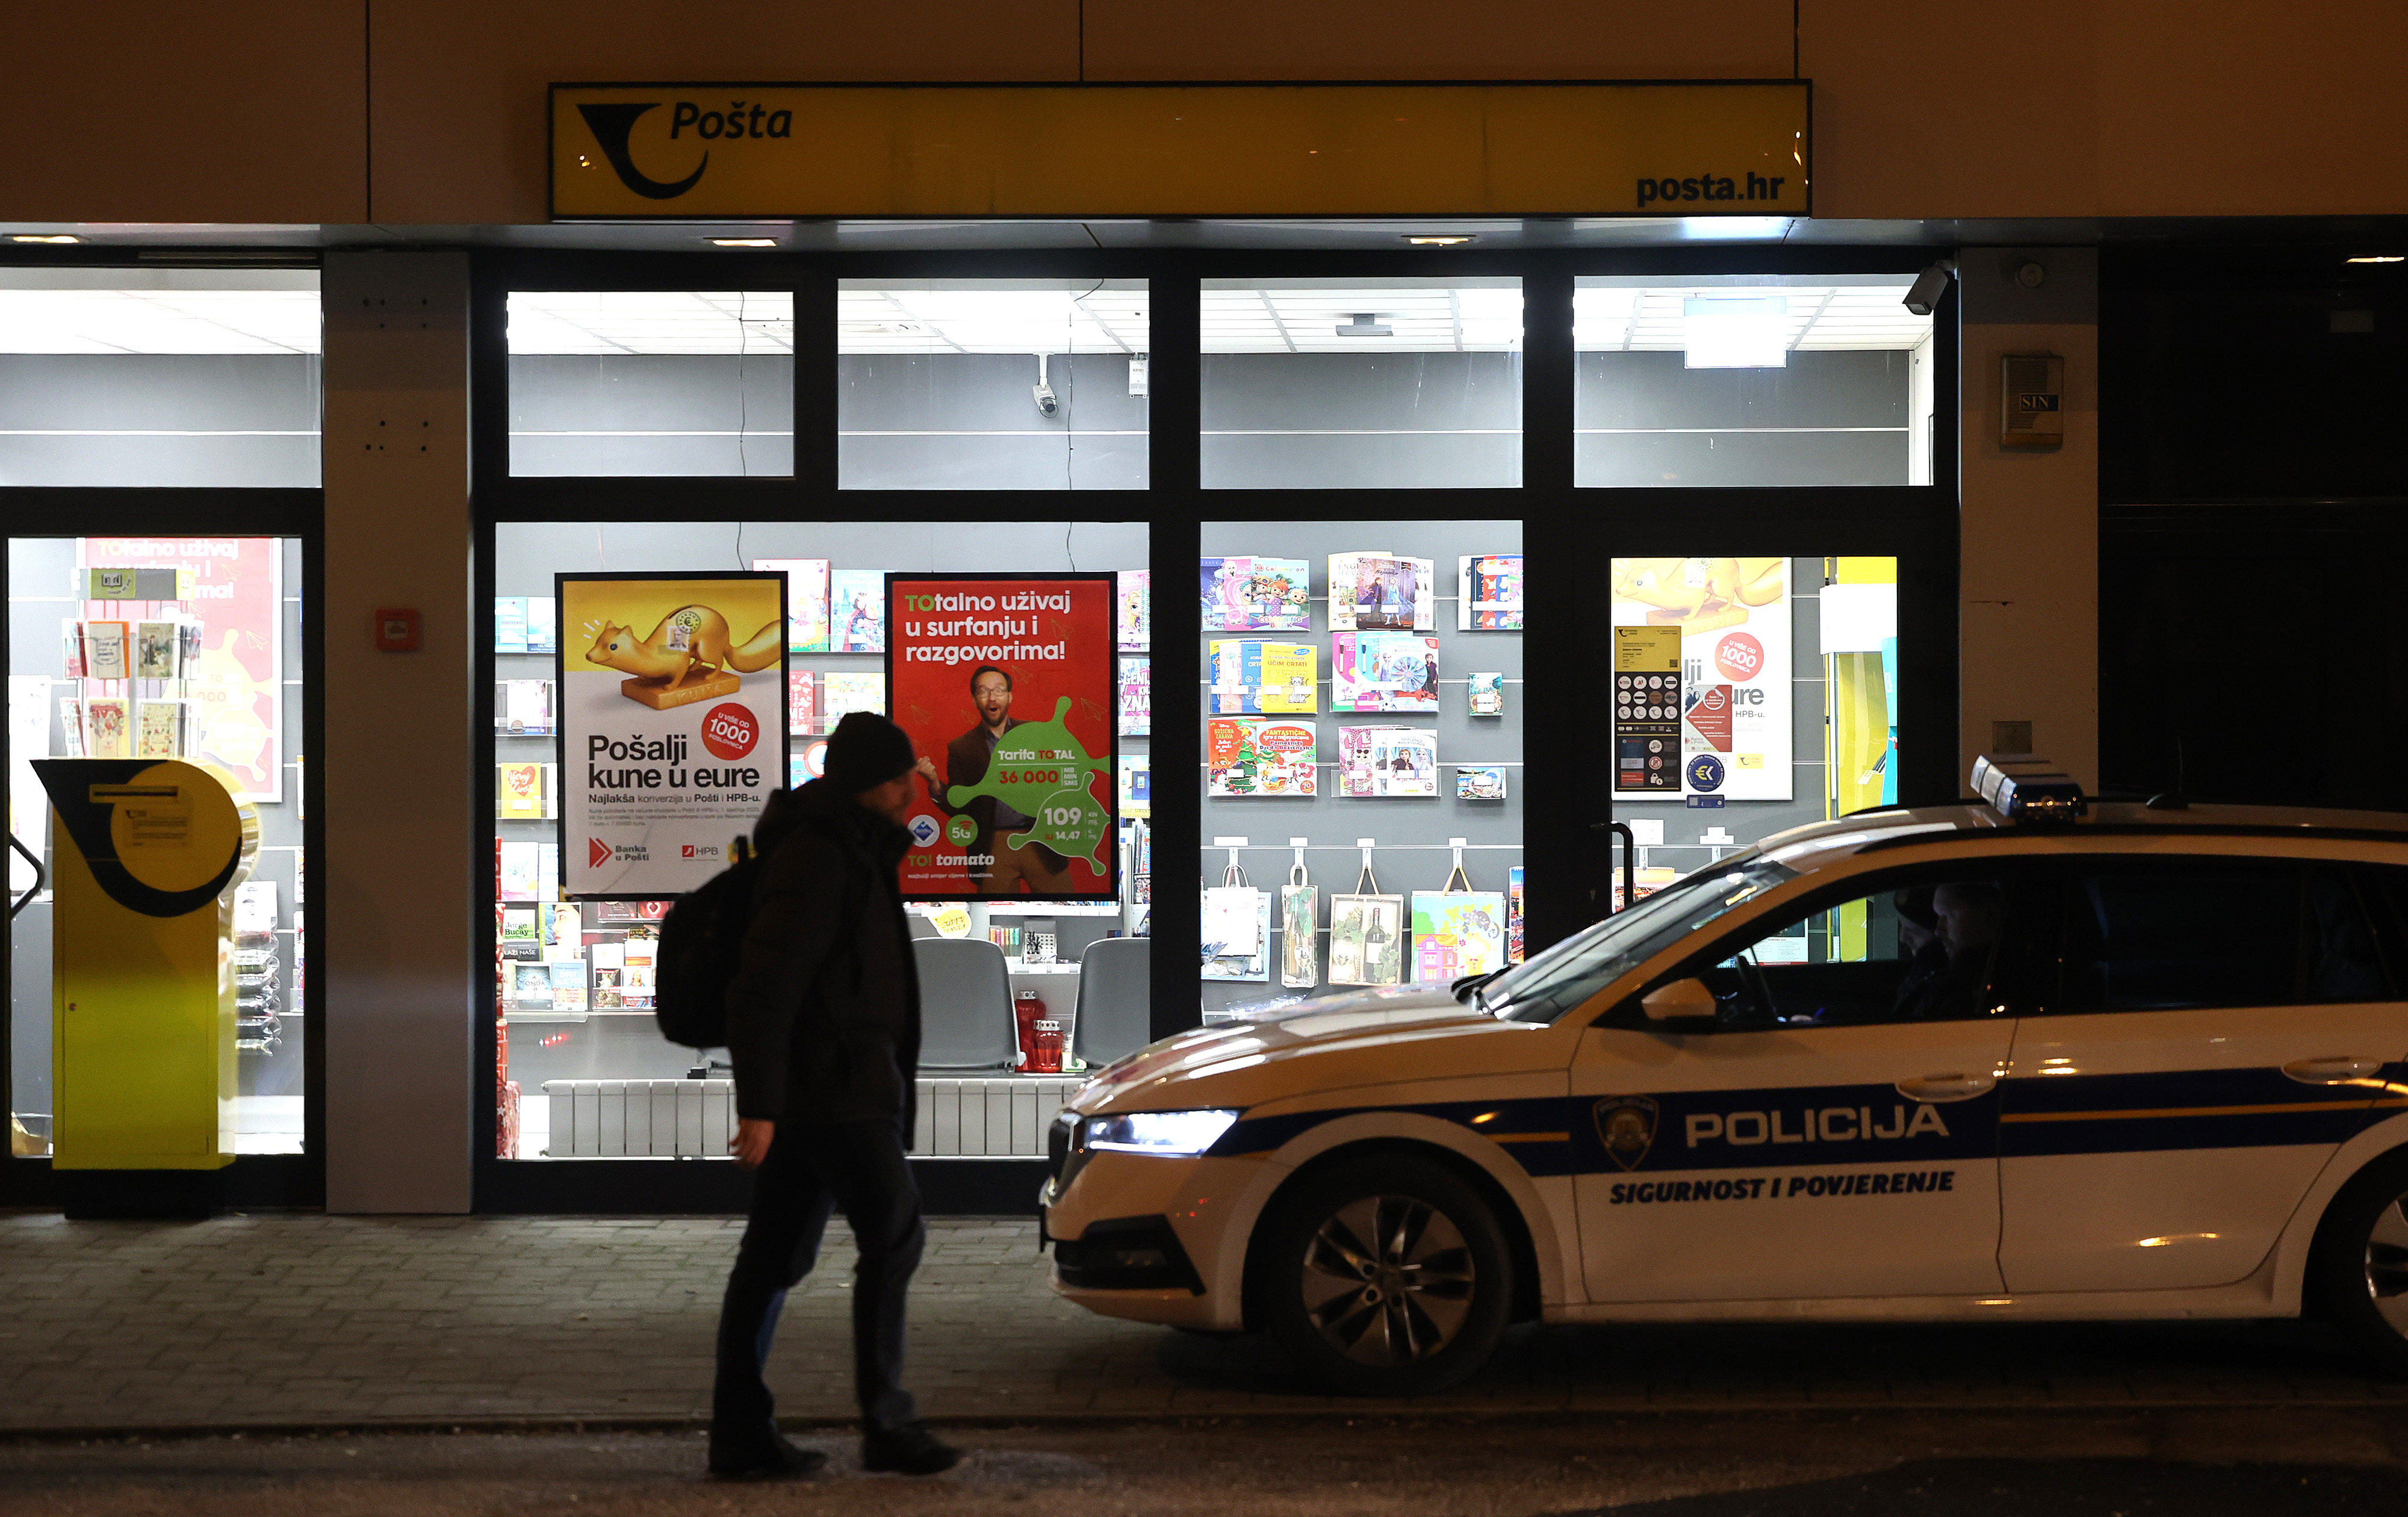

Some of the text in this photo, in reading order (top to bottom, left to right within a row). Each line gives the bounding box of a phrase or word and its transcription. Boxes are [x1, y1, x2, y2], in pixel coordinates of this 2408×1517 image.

[670, 101, 792, 140] Pošta
[1636, 172, 1785, 208] posta.hr
[2022, 395, 2049, 408] SIN
[97, 539, 239, 561] TOtalno uživaj
[905, 590, 1072, 614] TOtalno uživaj
[905, 616, 1038, 641] u surfanju i
[905, 641, 1066, 665] razgovorima!
[1734, 641, 1748, 651] VIŠE
[1720, 658, 1751, 674] POSLOVNICA
[1722, 645, 1757, 669] 1000
[724, 715, 739, 725] VIŠE
[739, 720, 750, 728] OD
[710, 718, 751, 744] 1000
[588, 734, 687, 766] Pošalji
[998, 749, 1076, 760] Tarifa TOTAL
[588, 763, 760, 789] kune u eure
[999, 770, 1060, 784] 36 000
[588, 794, 635, 805] Najlakša
[638, 794, 683, 805] konverzija
[694, 793, 719, 802] Pošti
[726, 794, 762, 802] HPB-u.
[1044, 807, 1082, 825] 109
[952, 827, 971, 839] 5G
[1055, 831, 1081, 841] 14,47
[696, 847, 719, 855] HPB
[908, 853, 996, 867] TO! tomato
[941, 917, 965, 929] SUPER
[1685, 1103, 1950, 1149] POLICIJA
[1609, 1171, 1955, 1205] SIGURNOST I POVJERENJE
